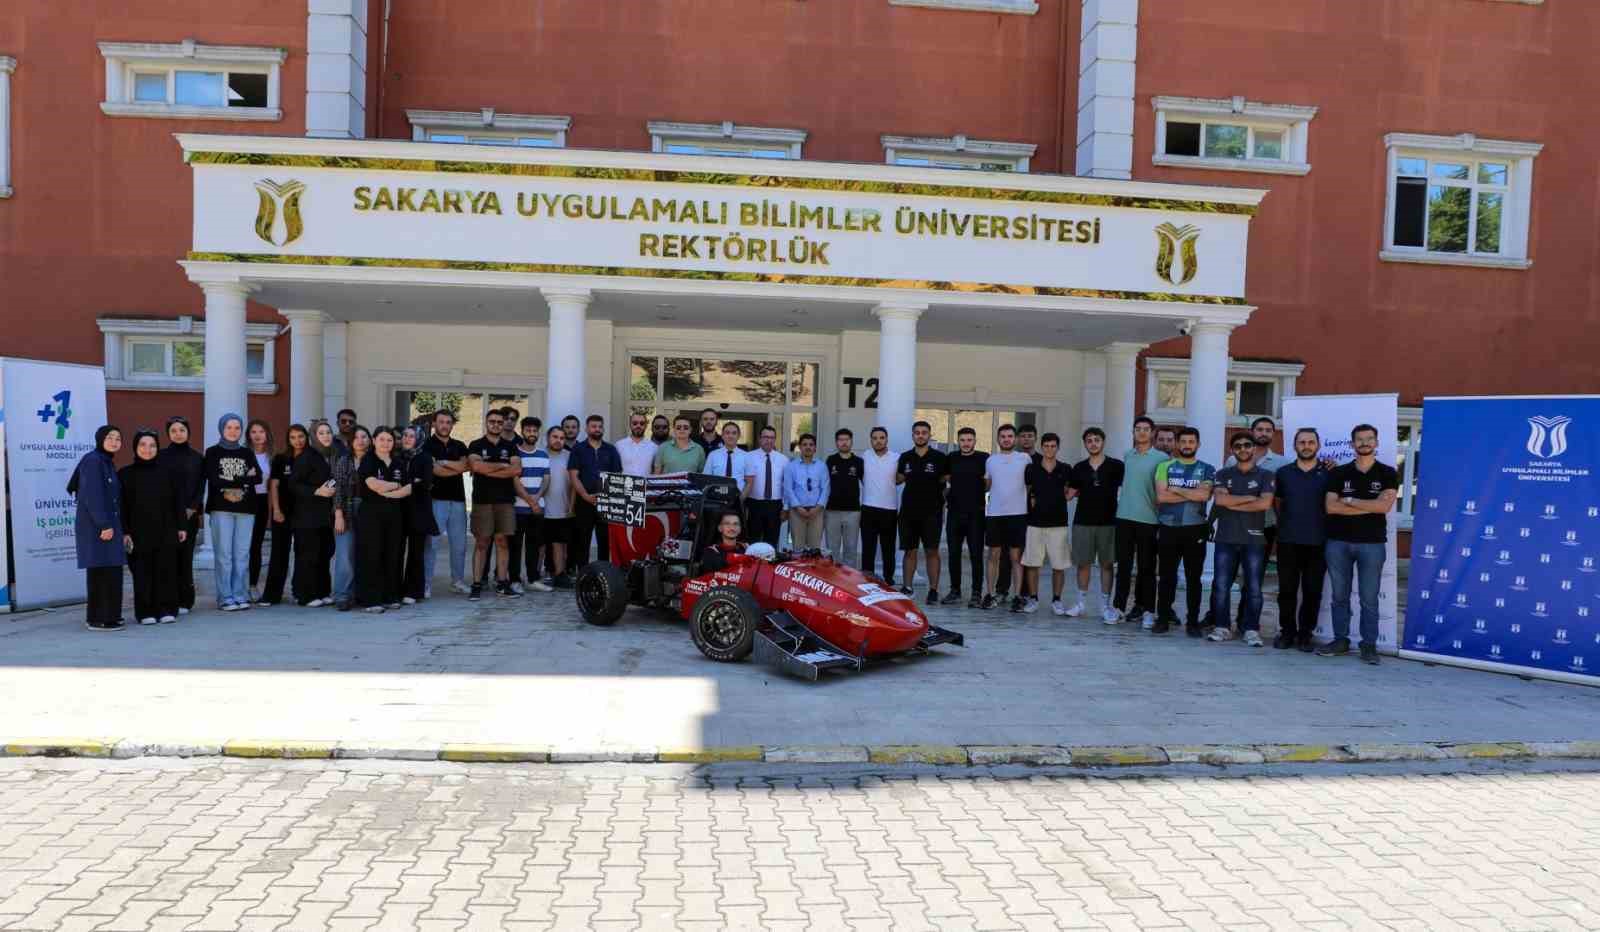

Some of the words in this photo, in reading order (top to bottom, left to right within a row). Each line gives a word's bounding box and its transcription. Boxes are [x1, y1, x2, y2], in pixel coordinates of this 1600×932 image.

[354, 186, 502, 215] SAKARYA
[516, 191, 728, 226] UYGULAMALI
[740, 199, 882, 232] BİLİMLER
[895, 206, 1101, 244] ÜNİVERSİTESİ
[639, 232, 831, 265] REKTÖRLÜK
[843, 377, 880, 408] T2
[626, 504, 643, 526] 54
[792, 570, 835, 597] SAKARYA
